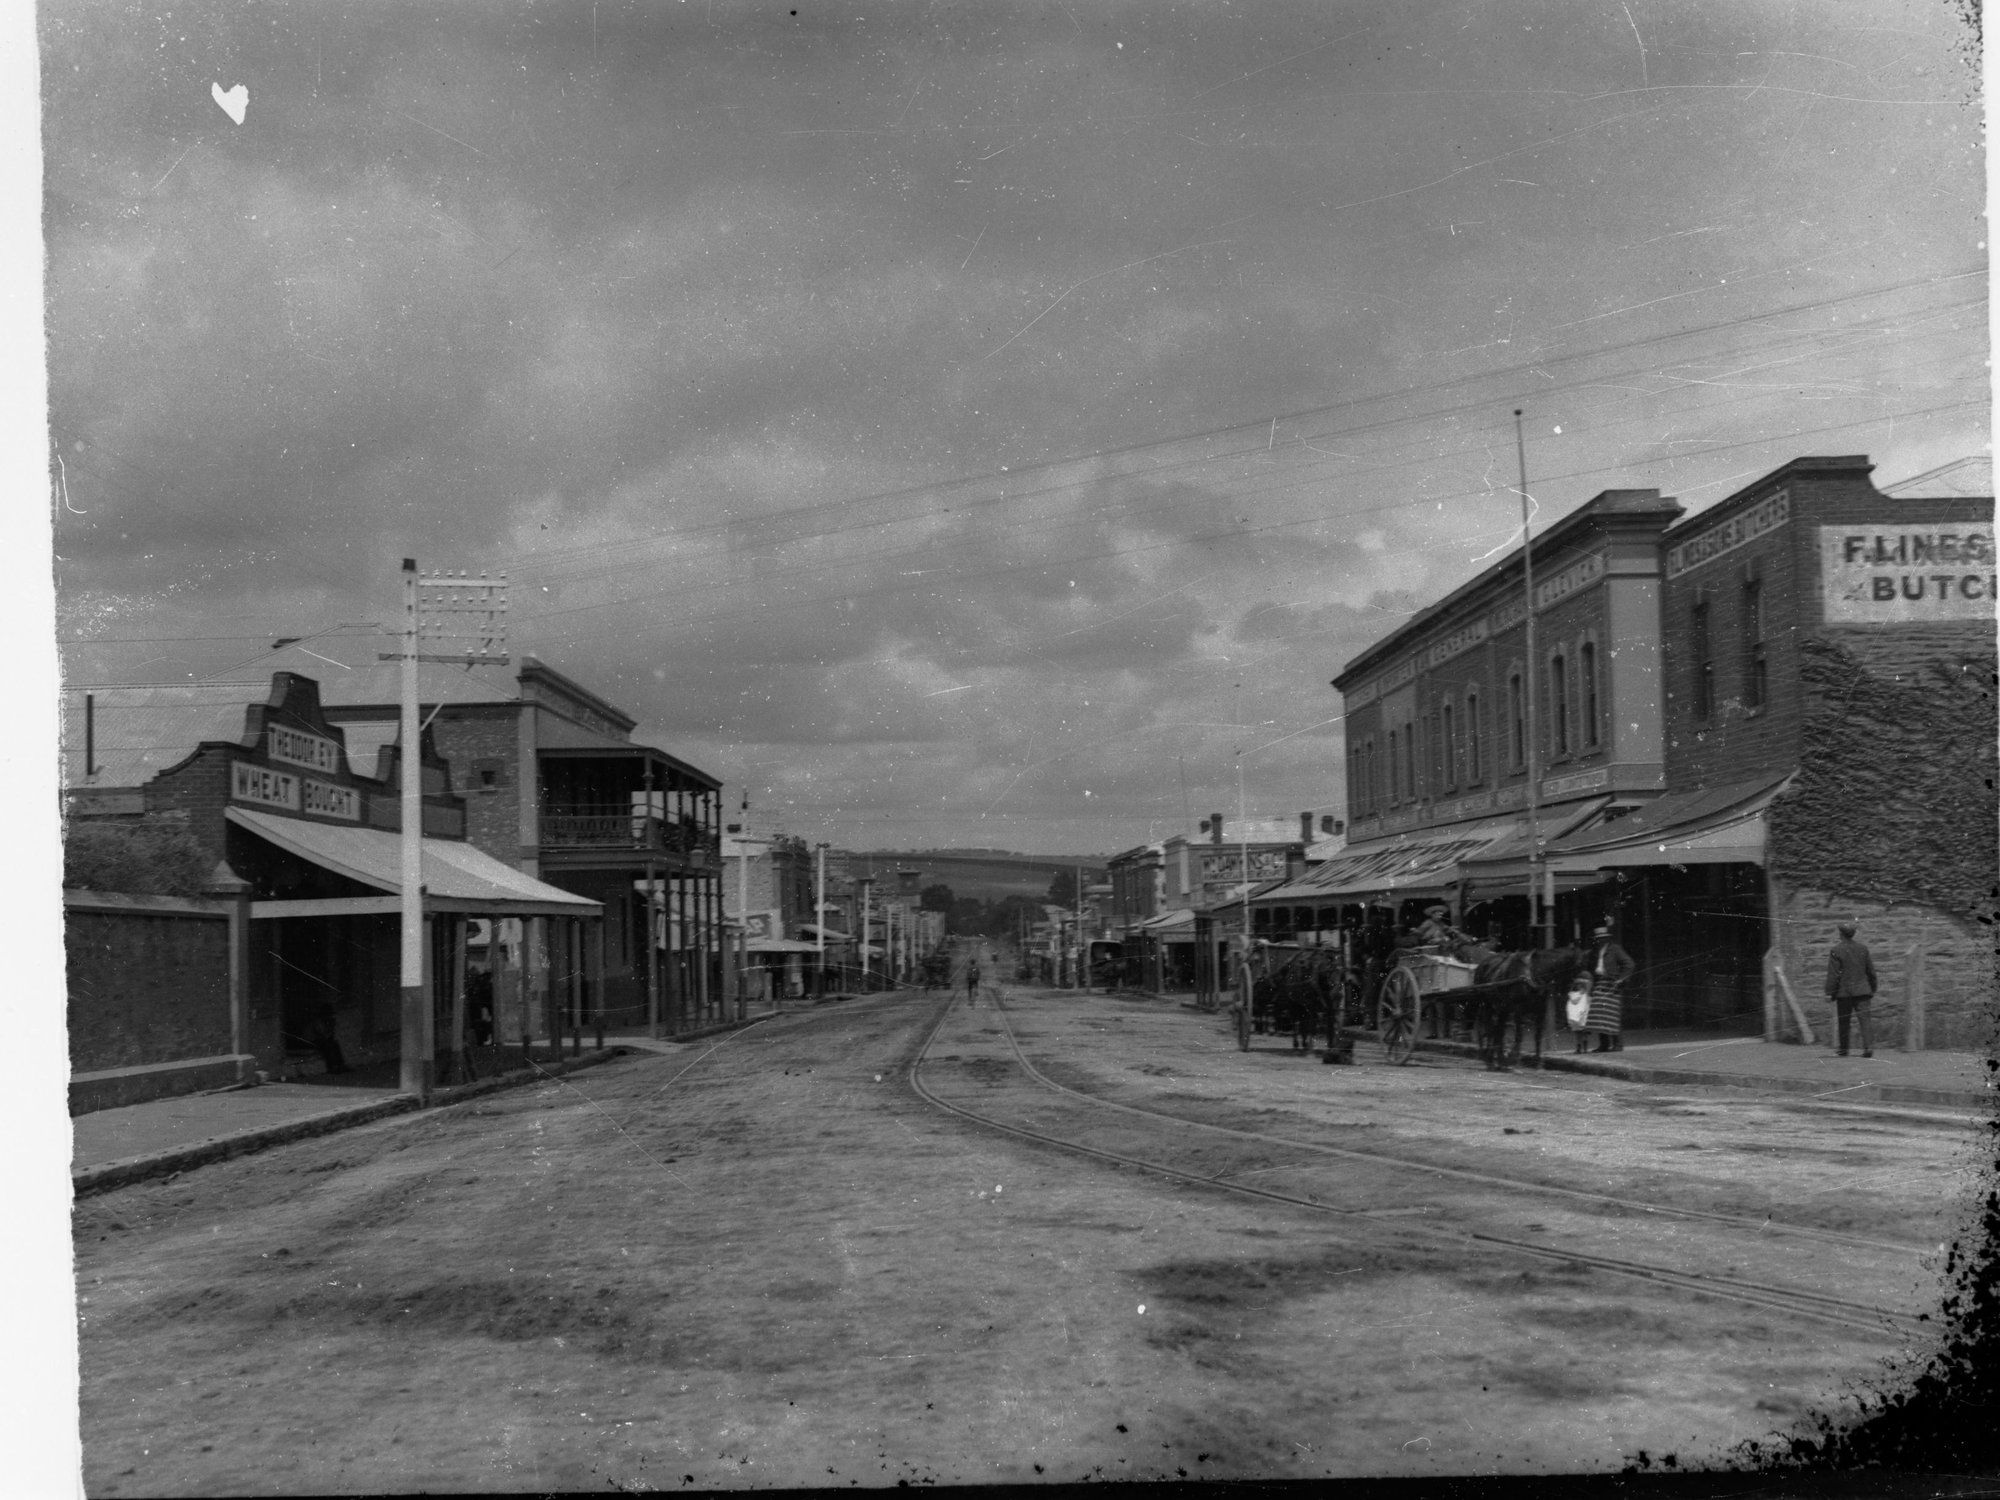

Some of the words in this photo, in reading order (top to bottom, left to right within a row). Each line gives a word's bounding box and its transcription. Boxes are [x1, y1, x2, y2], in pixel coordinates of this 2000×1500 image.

[1872, 574, 1997, 601] BUTC
[238, 766, 291, 804] WHEAT
[306, 782, 353, 816] BOUGHT
